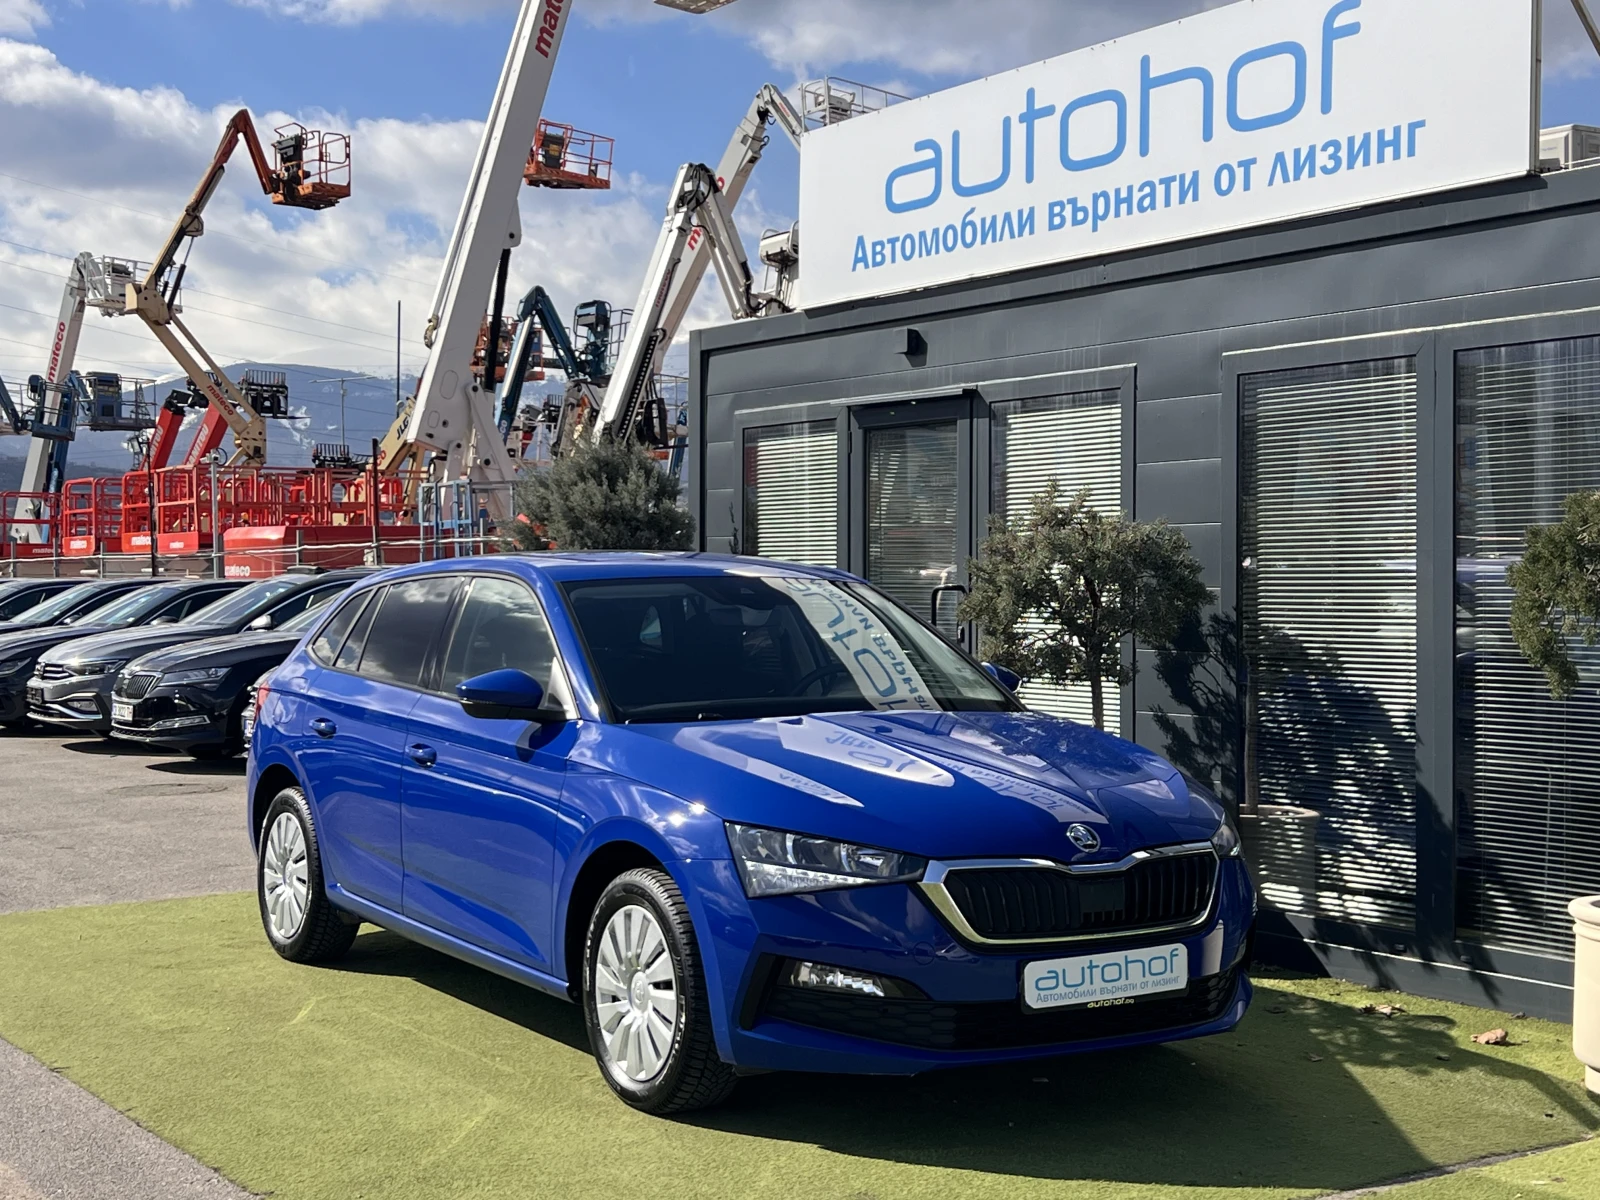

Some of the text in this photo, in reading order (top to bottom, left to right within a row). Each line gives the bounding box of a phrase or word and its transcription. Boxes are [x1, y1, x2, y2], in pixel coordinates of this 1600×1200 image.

[885, 0, 1361, 215] autohof
[852, 120, 1426, 272] Автомобили върнати от лизинг
[48, 321, 66, 383] mateco
[206, 385, 234, 416] mateco
[397, 416, 409, 441] JLG
[1035, 948, 1179, 992] autohof
[1036, 976, 1180, 1003] Автомобили върнати от лизинг
